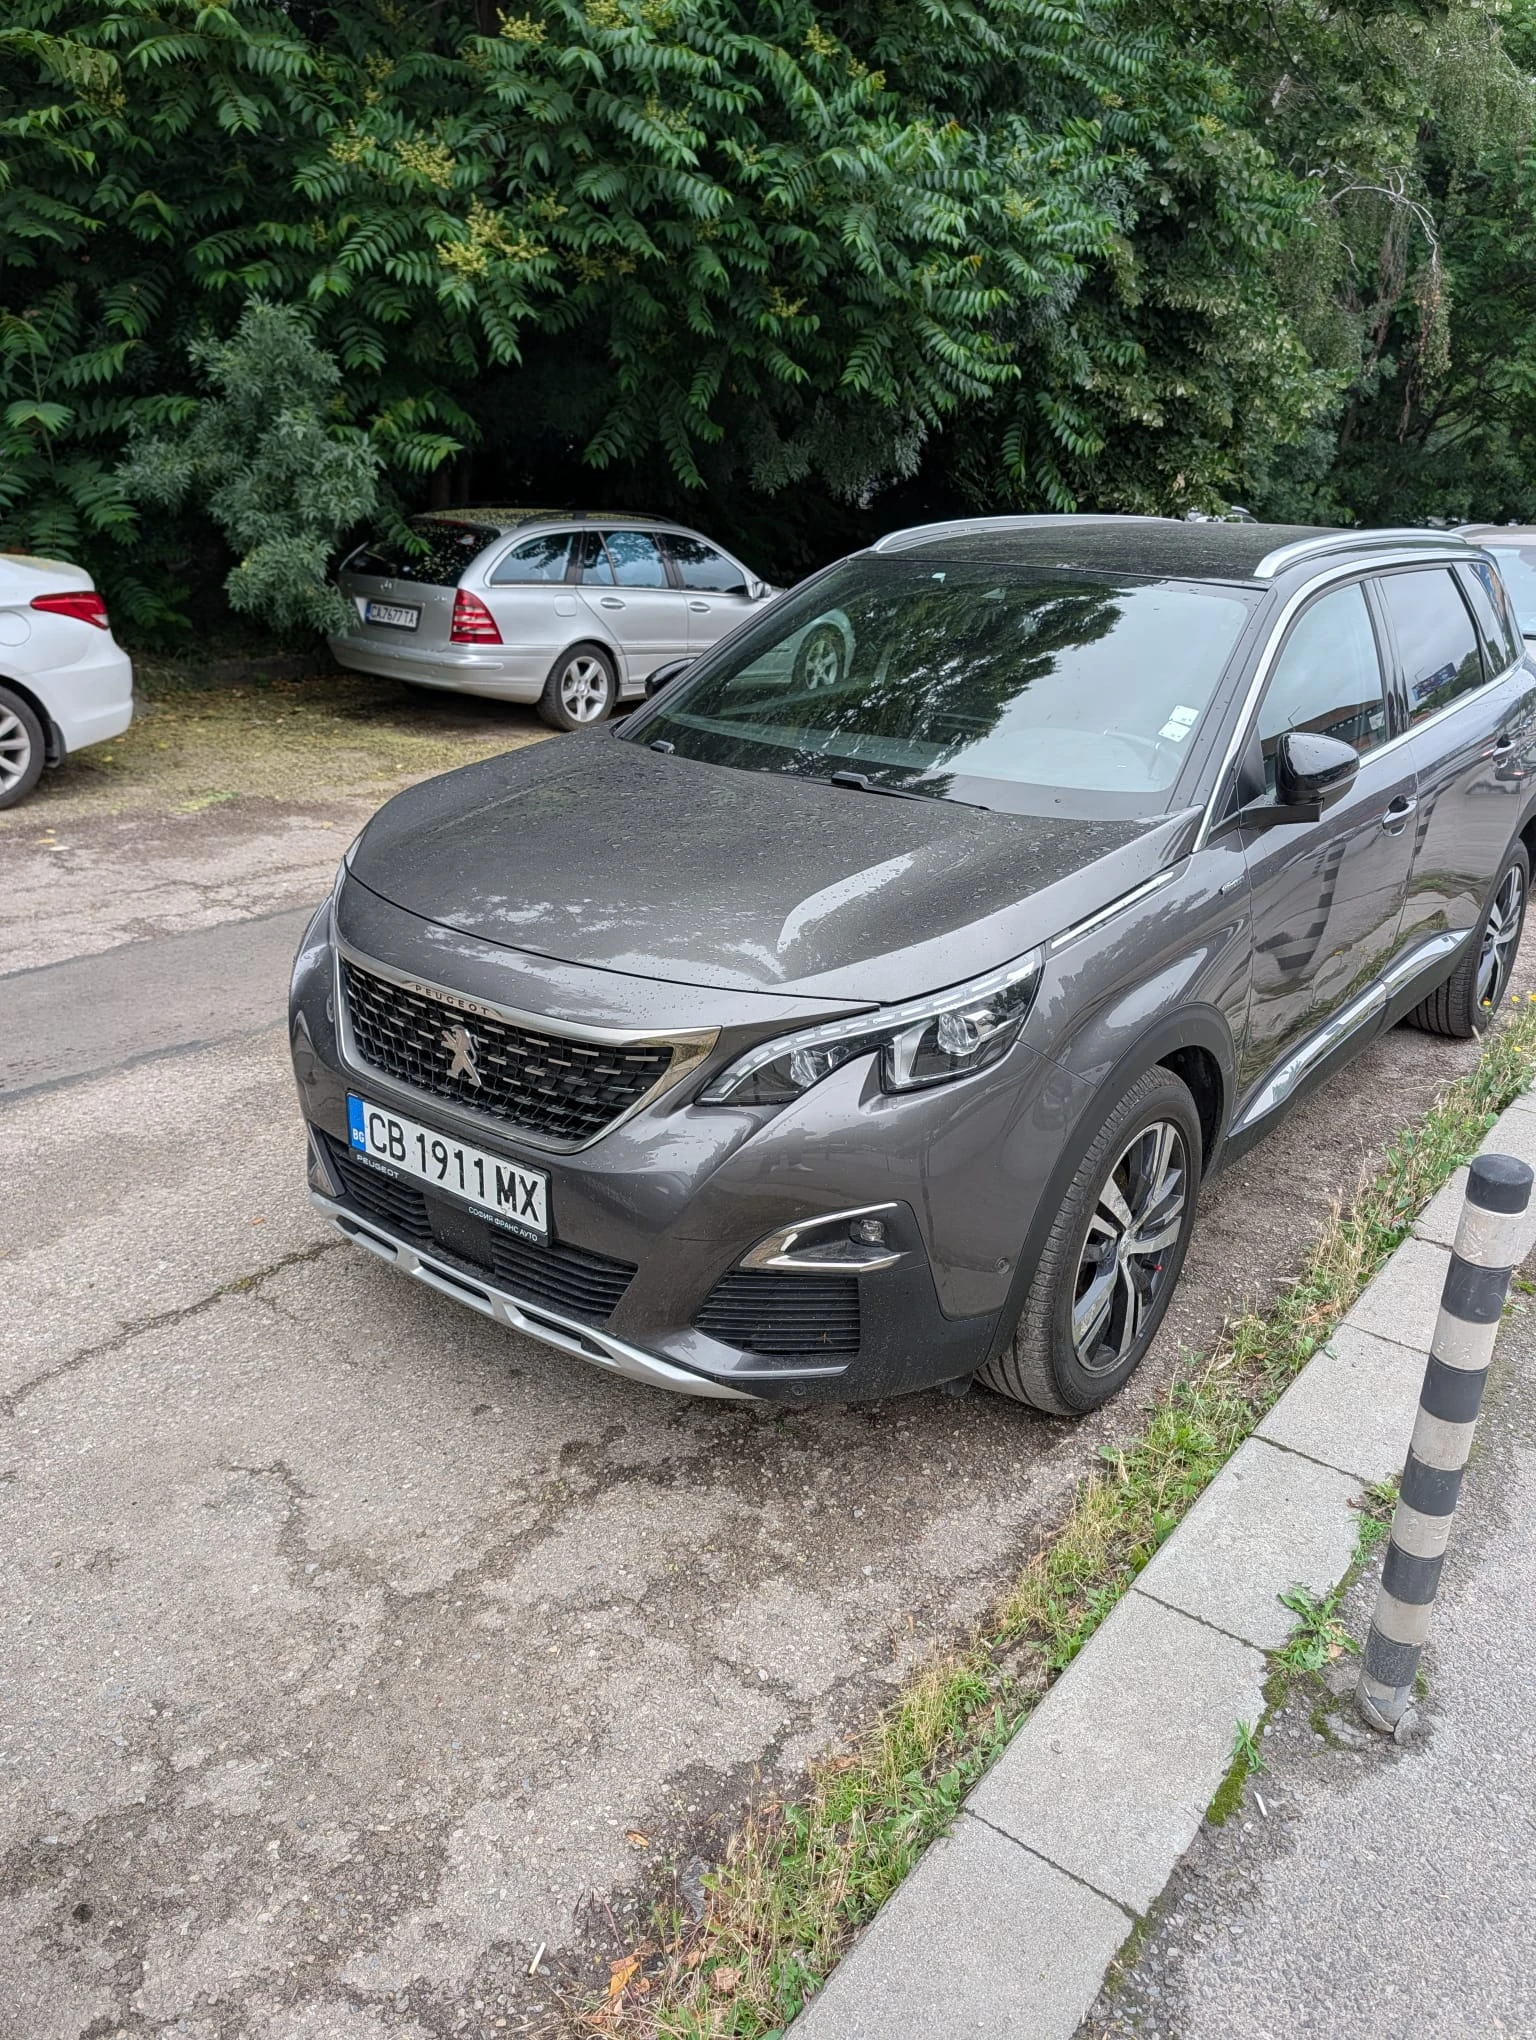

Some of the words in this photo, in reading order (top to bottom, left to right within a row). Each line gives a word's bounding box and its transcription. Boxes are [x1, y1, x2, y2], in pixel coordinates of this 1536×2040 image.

[415, 984, 490, 1015] PEUGEOT
[352, 1127, 365, 1143] BG
[356, 1154, 399, 1178] PEUGEOT
[468, 1206, 494, 1223] СОФИЯ
[494, 1217, 519, 1234] ФРАНС
[519, 1228, 538, 1242] АУТО
